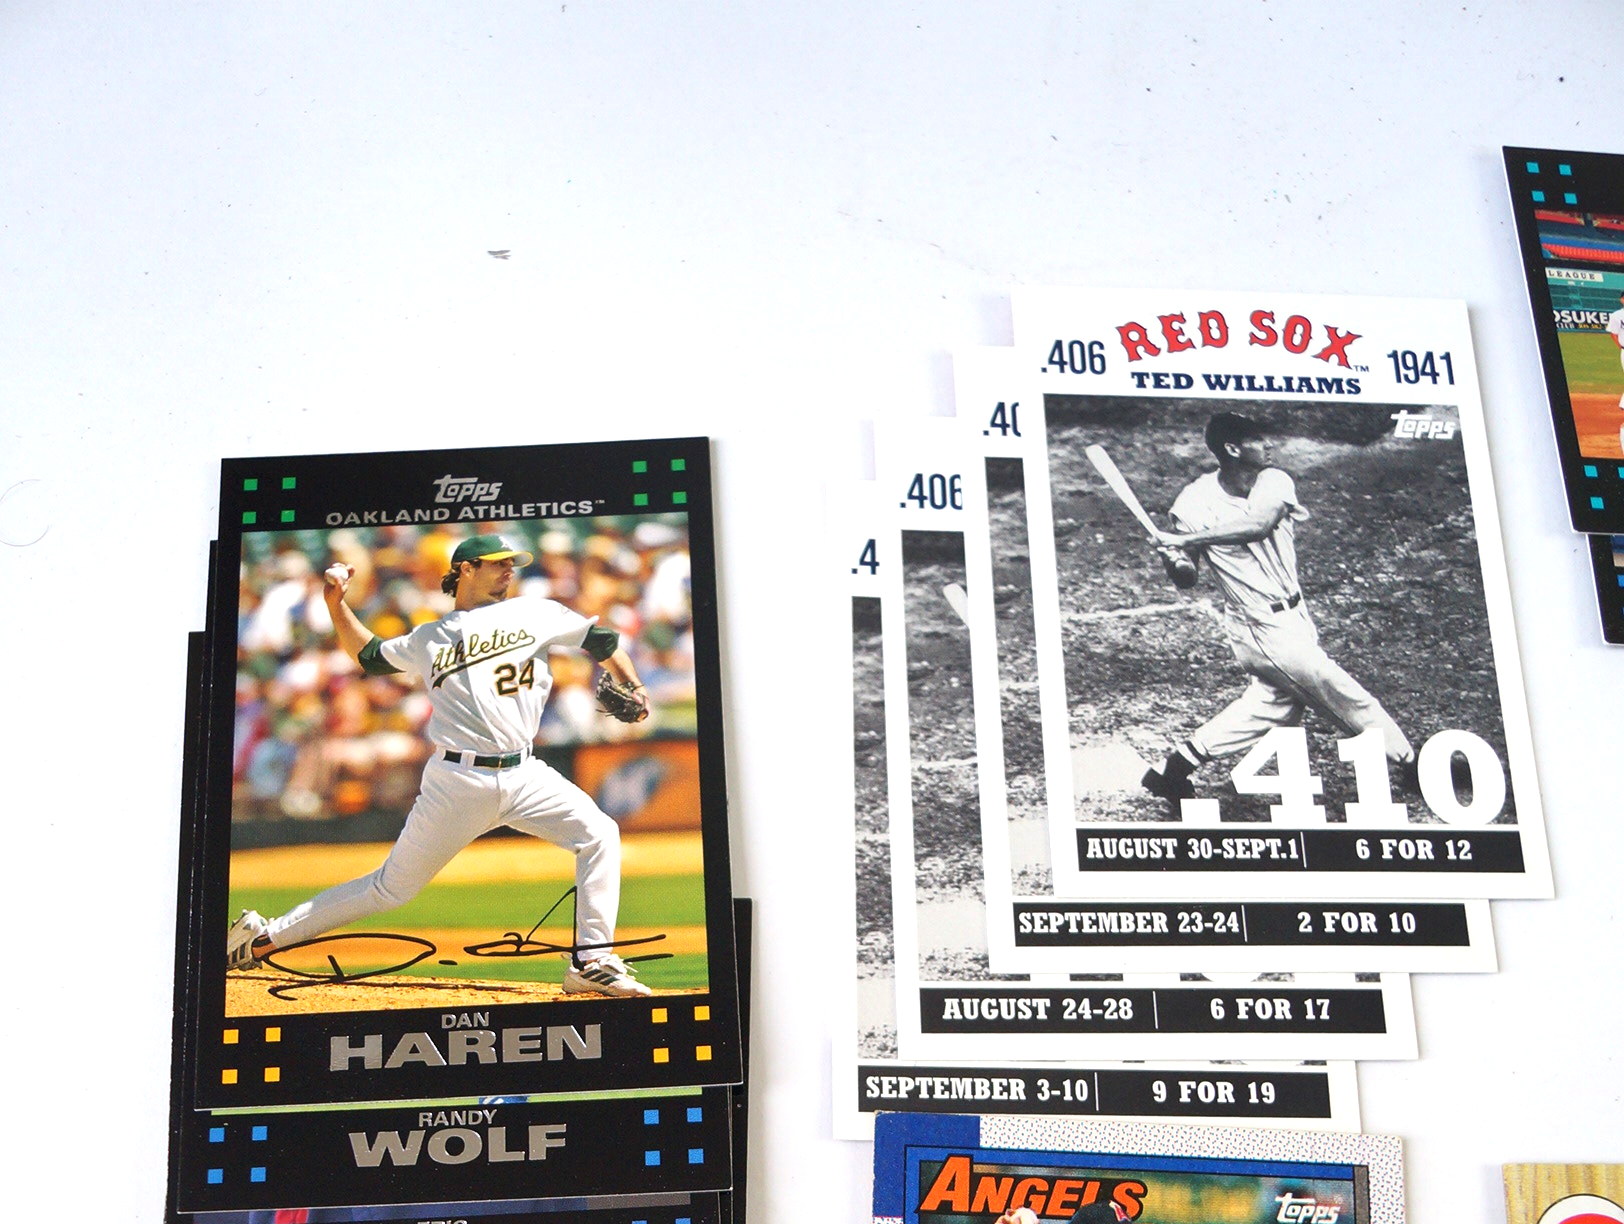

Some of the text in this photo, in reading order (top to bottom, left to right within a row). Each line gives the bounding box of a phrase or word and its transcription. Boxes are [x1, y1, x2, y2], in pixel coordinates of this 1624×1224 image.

[1040, 338, 1107, 375] .406
[1115, 309, 1230, 363] RED
[1248, 309, 1364, 370] SOX
[1130, 371, 1362, 395] TED WILLIAMS
[1387, 349, 1456, 385] 1941
[325, 508, 450, 526] OAKLAND
[431, 629, 537, 690] Athletics
[494, 657, 536, 697] 24
[1180, 726, 1506, 826] .410
[1087, 838, 1179, 861] AUGUST
[1355, 839, 1371, 859] 6
[1380, 840, 1438, 860] FOR
[1445, 840, 1473, 860] 12
[1018, 911, 1416, 934] SEPTEMBER 23-24 2 FOR 10
[441, 1011, 490, 1029] DAN
[941, 998, 1331, 1021] AUGUST 24-28 6 FOR 17
[329, 1024, 603, 1071] HAREN
[865, 1075, 1276, 1104] SEPTEMBER 3-10 9 FOR 19
[418, 1108, 498, 1128] RANDY
[348, 1123, 567, 1168] WOLF
[920, 1156, 1145, 1219] ANGELS
